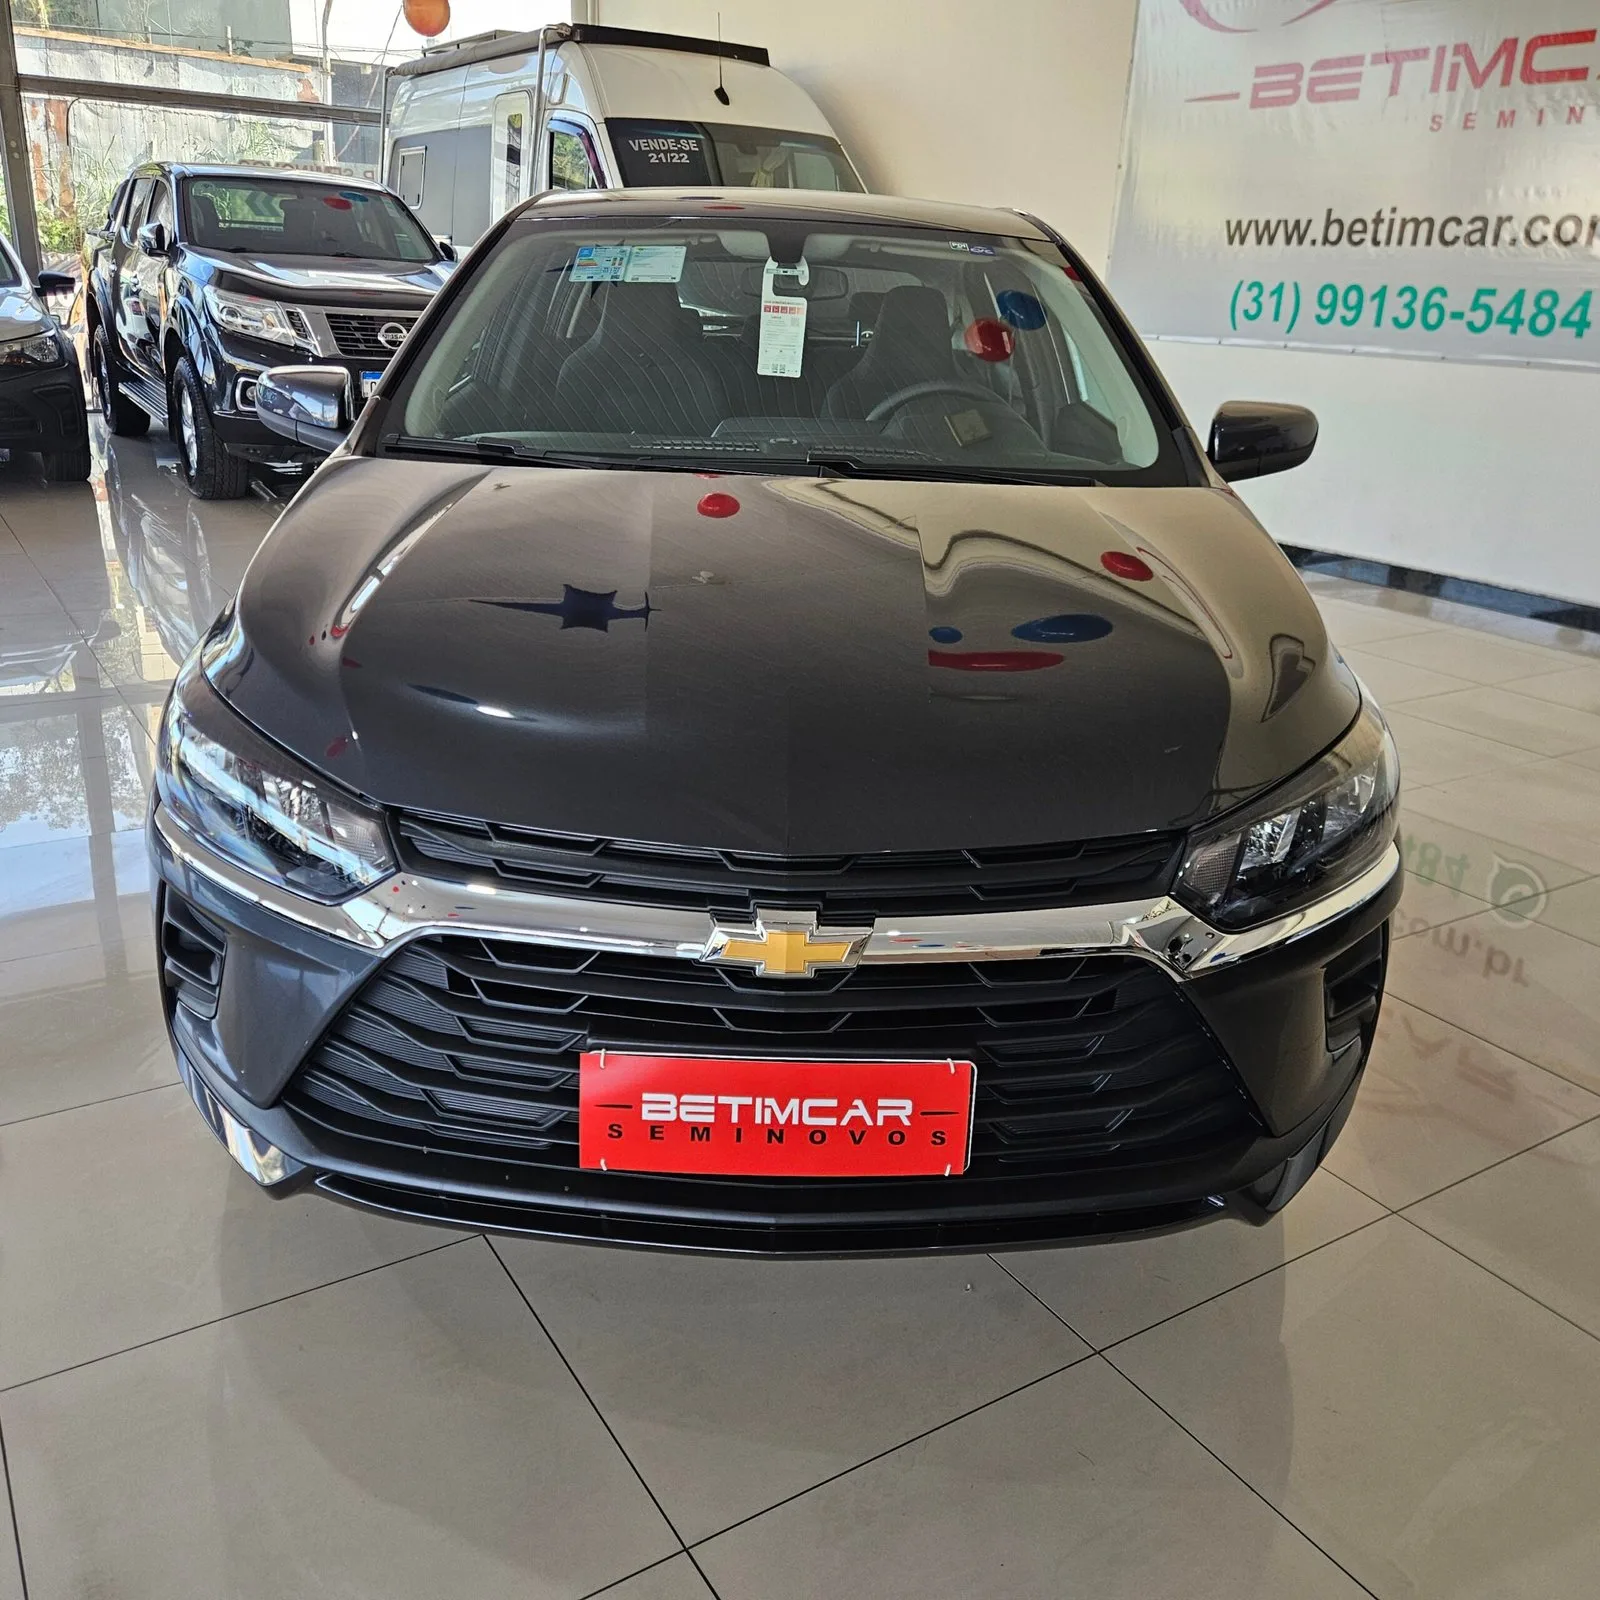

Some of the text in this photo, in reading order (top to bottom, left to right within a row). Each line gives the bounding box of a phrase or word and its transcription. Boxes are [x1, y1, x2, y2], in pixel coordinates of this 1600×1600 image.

[1248, 28, 1600, 110] BETIMC
[1429, 105, 1585, 132] SEMIN
[628, 138, 699, 151] VENDE-SE
[648, 153, 690, 163] 21/22
[1229, 280, 1593, 338] (31) 99136-5484
[641, 1092, 913, 1127] BETIMCAR
[607, 1123, 947, 1146] SEMINOVOS
